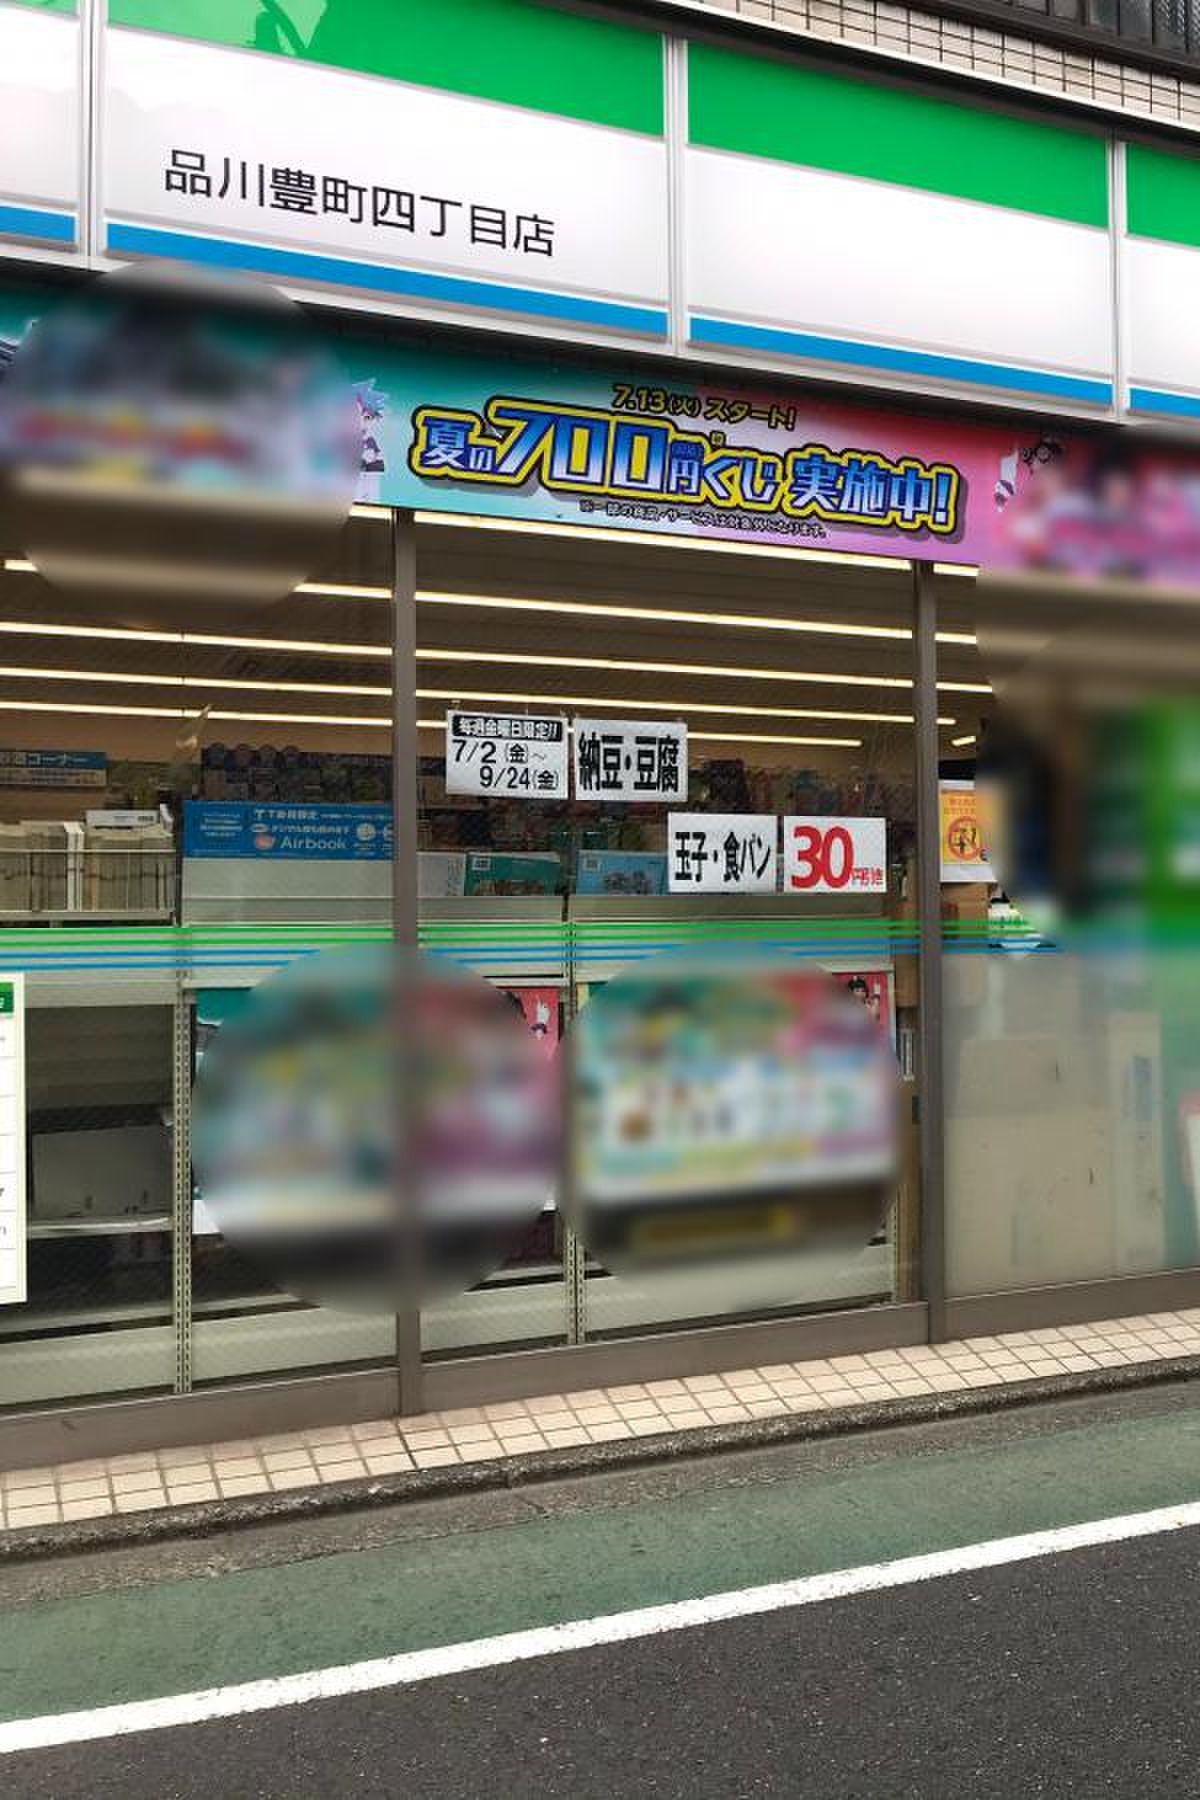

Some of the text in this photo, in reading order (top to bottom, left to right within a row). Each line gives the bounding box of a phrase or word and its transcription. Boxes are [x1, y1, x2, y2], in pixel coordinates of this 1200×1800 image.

[164, 148, 555, 257] 品川豊町四丁目店
[479, 766, 559, 791] 9/24(金)
[578, 731, 680, 793] 納豆・豆腐
[674, 831, 771, 883] 玉子・食パン
